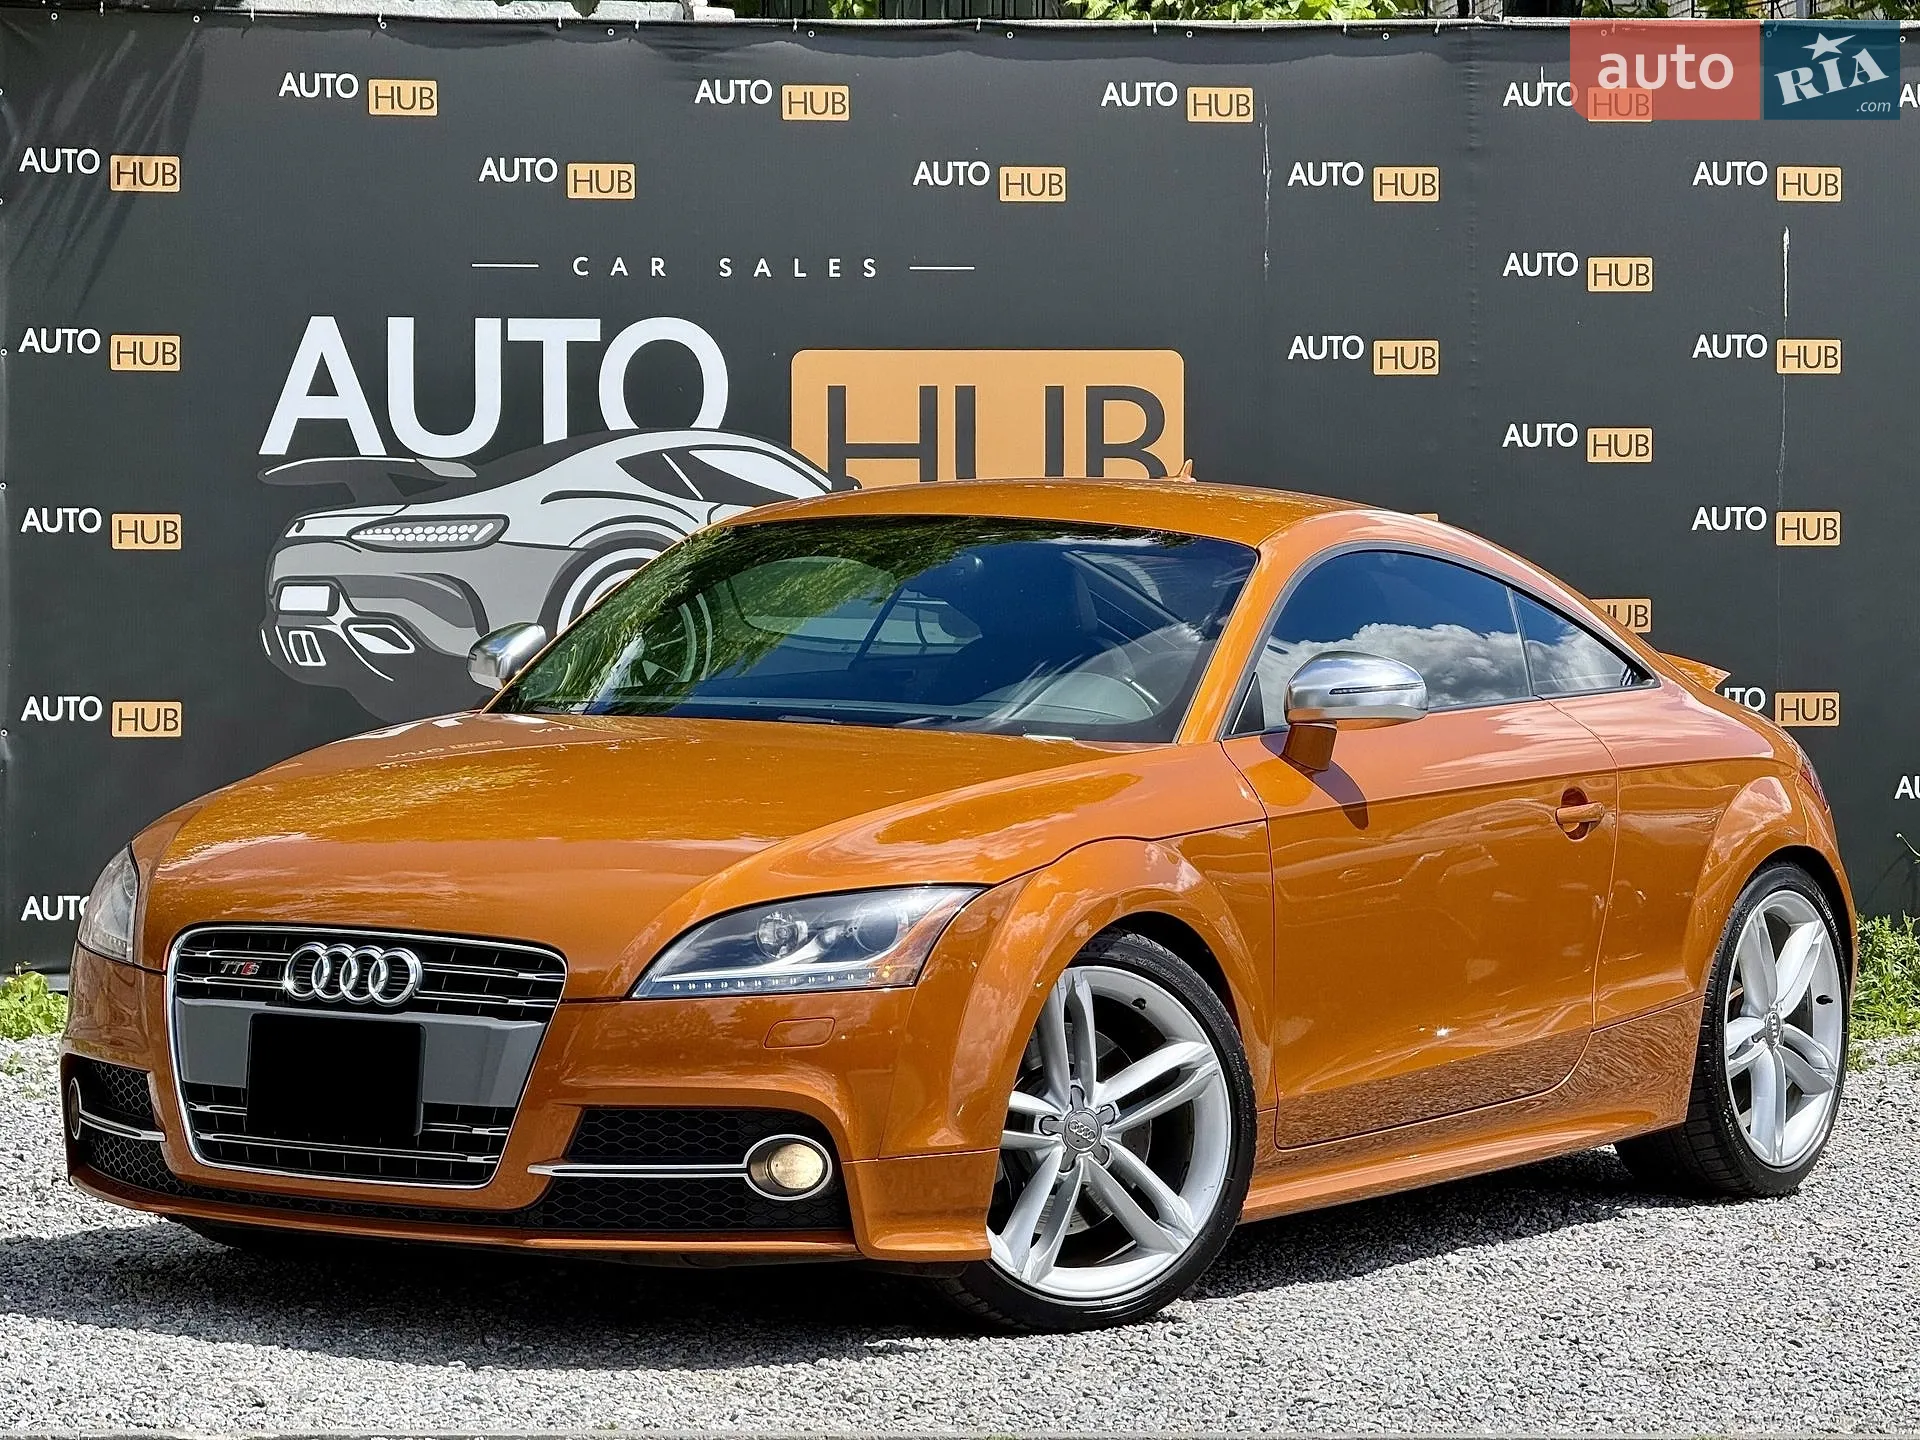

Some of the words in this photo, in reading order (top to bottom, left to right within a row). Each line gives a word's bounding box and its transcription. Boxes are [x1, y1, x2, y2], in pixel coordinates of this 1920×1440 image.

[279, 72, 358, 98] AUTO
[375, 86, 434, 110] HUB
[695, 79, 772, 104] AUTO
[788, 92, 846, 115] HUB
[1101, 82, 1177, 107] AUTO
[1193, 94, 1250, 117] HUB
[1503, 82, 1579, 107] AUTO
[1592, 93, 1650, 117] HUB
[19, 148, 100, 174] AUTO
[116, 162, 177, 186] HUB
[479, 157, 557, 182] AUTO
[573, 170, 632, 193] HUB
[913, 161, 990, 186] AUTO
[1005, 173, 1062, 196] HUB
[1288, 162, 1364, 187] AUTO
[1379, 173, 1436, 196] HUB
[1693, 161, 1767, 186] AUTO
[1782, 173, 1838, 196] HUB
[572, 256, 667, 277] CAR
[719, 257, 877, 278] SALES
[1503, 252, 1578, 277] AUTO
[1593, 264, 1649, 287] HUB
[19, 328, 100, 353] AUTO
[116, 341, 177, 365] HUB
[1288, 335, 1364, 360] AUTO
[1379, 347, 1436, 369] HUB
[1693, 334, 1767, 358] AUTO
[1782, 346, 1838, 368] HUB
[259, 316, 729, 459] AUTO
[1503, 423, 1578, 448] AUTO
[1593, 434, 1649, 457] HUB
[21, 508, 102, 533] AUTO
[118, 520, 178, 544] HUB
[1692, 507, 1766, 531] AUTO
[1782, 518, 1837, 541] HUB
[21, 696, 102, 721] AUTO
[118, 708, 178, 732] HUB
[1780, 698, 1836, 721] HUB
